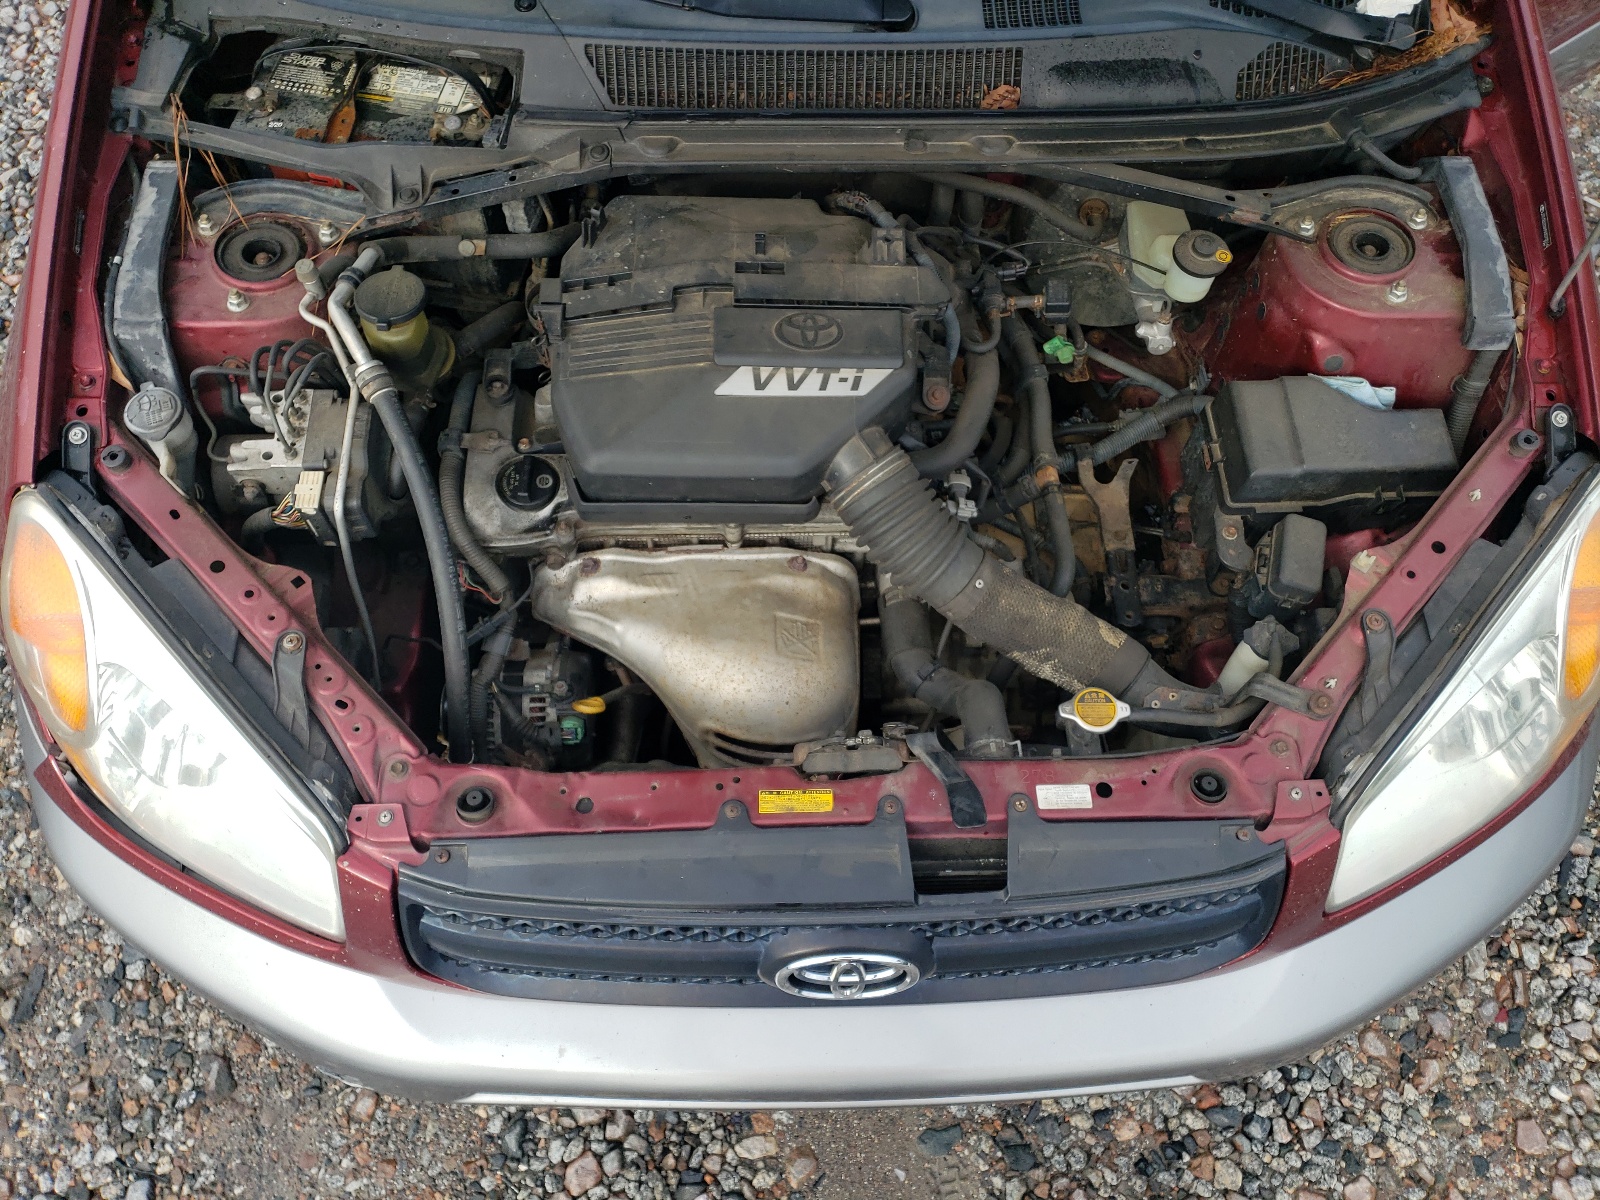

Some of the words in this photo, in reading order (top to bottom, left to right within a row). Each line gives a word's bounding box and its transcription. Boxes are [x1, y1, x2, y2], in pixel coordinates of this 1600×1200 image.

[281, 56, 325, 68] START
[289, 52, 326, 63] SUPER
[751, 366, 864, 391] VVT-i
